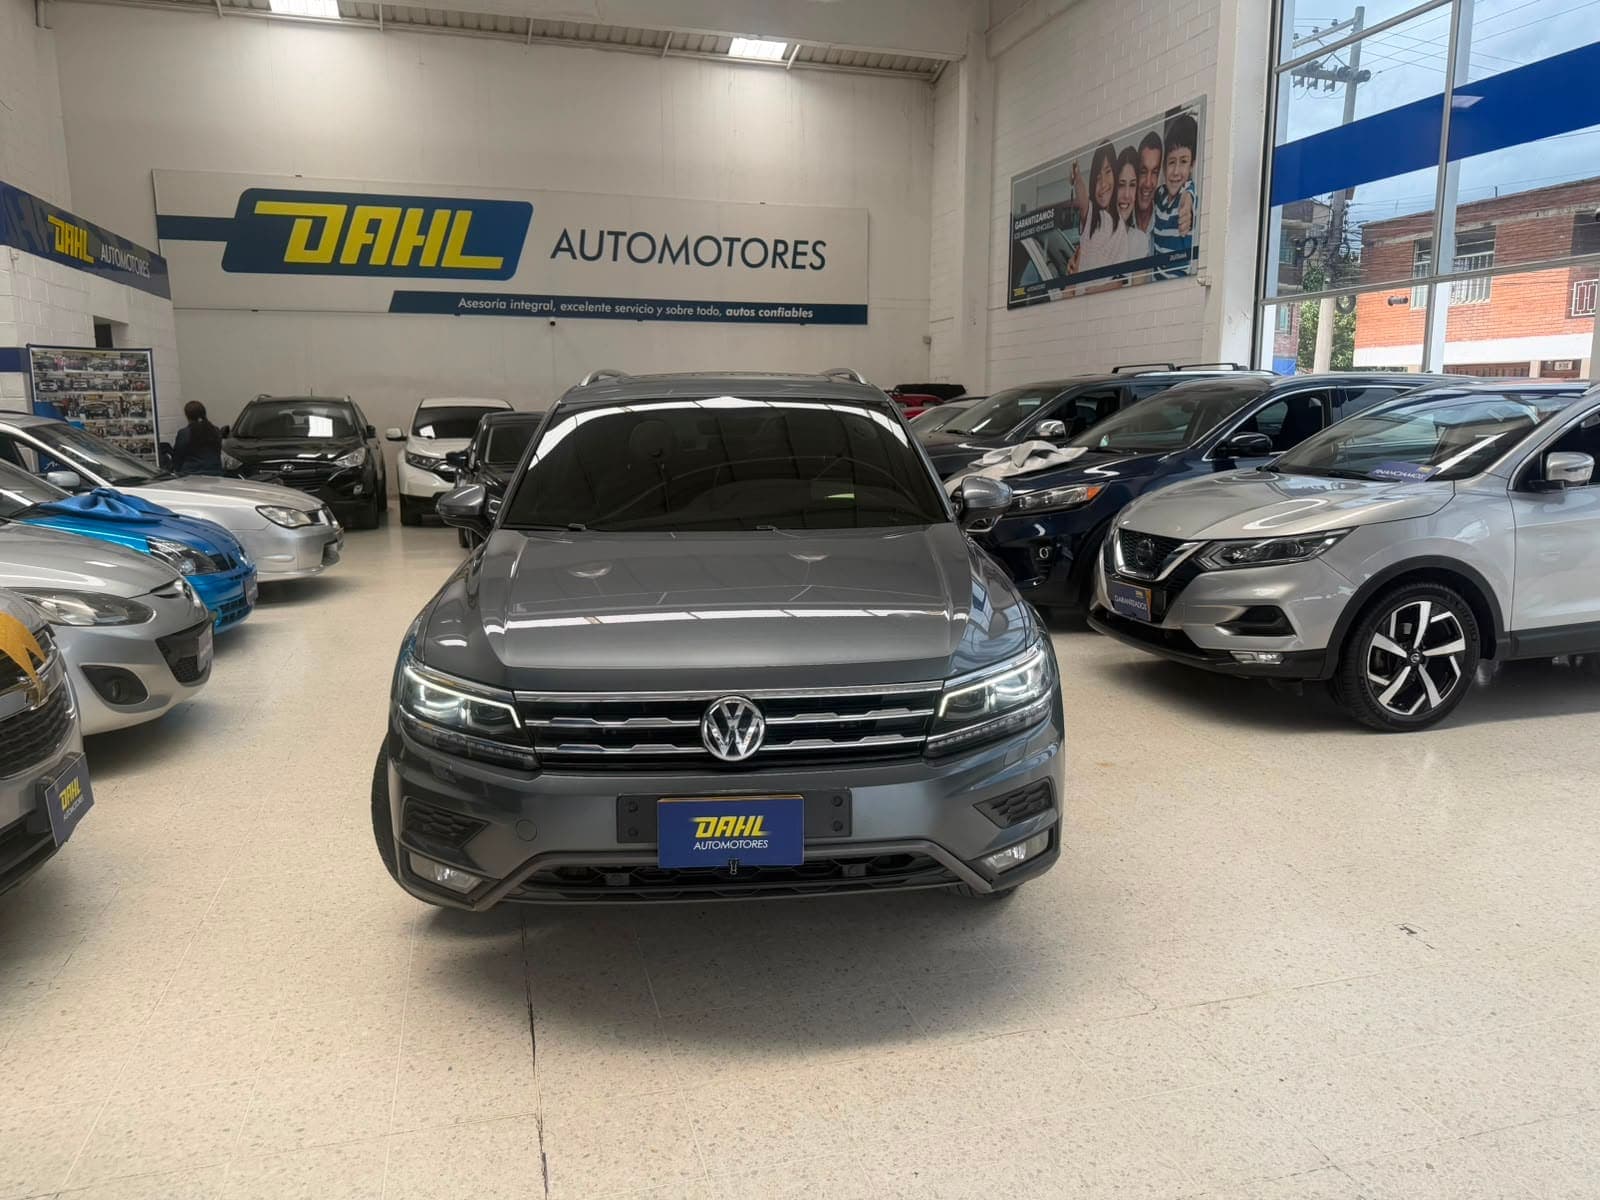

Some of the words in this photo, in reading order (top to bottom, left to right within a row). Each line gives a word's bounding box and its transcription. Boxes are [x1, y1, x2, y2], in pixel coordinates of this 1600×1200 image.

[47, 214, 95, 265] DAHL
[100, 243, 151, 279] AUTOMOTORES
[254, 201, 504, 270] DAHL
[550, 228, 827, 271] AUTOMOTORES
[510, 299, 556, 312] integral,
[560, 301, 612, 313] excelente
[614, 304, 654, 315] servicio
[656, 306, 663, 317] y
[665, 305, 694, 316] sobre
[696, 306, 722, 317] todo,
[725, 308, 755, 318] autos
[758, 307, 814, 319] confiables
[58, 776, 82, 812] DAHL
[689, 816, 770, 838] DAHL
[693, 839, 769, 850] AUTOMOTORES
